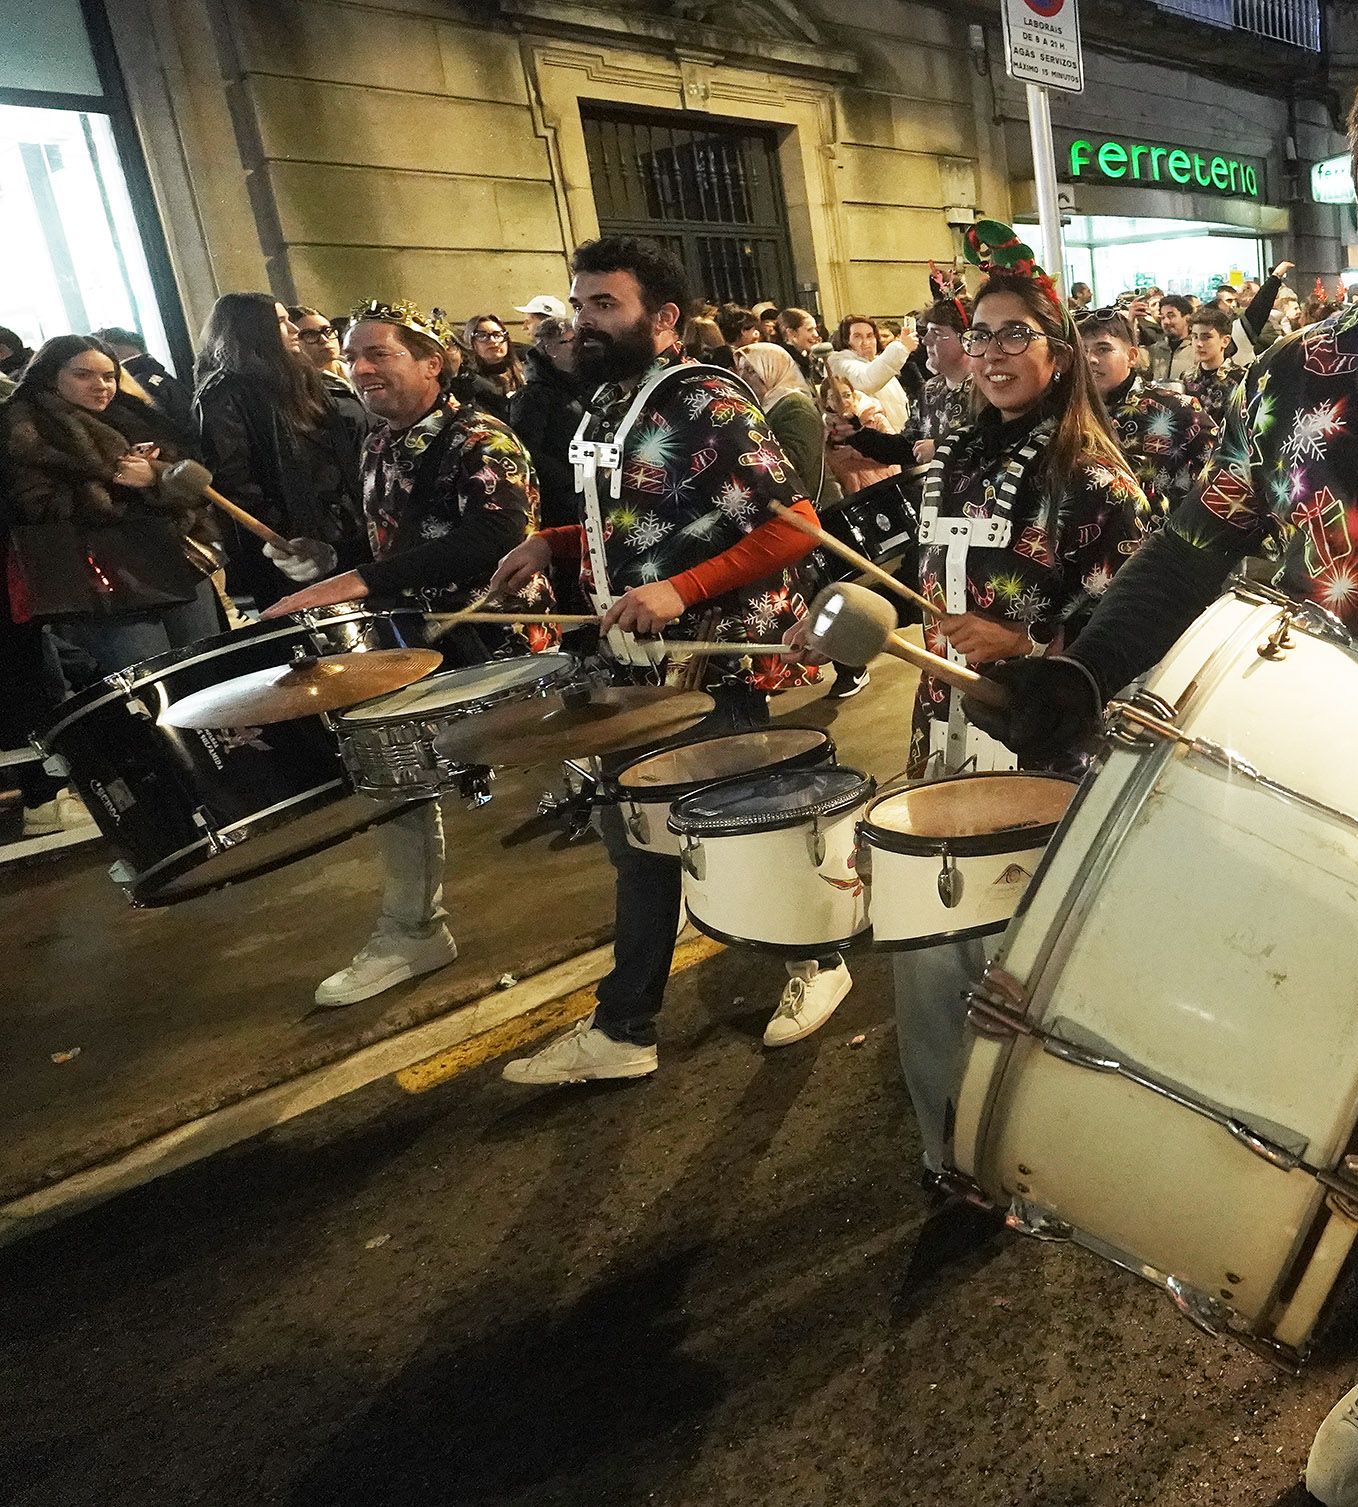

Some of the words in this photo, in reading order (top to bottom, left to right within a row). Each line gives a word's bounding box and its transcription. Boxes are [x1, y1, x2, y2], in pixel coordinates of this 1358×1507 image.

[1023, 17, 1063, 35] LABORAIS
[1022, 32, 1033, 41] DE
[1042, 38, 1048, 46] A
[1040, 53, 1077, 70] SERVIZOS
[1051, 71, 1079, 83] MINUTOS
